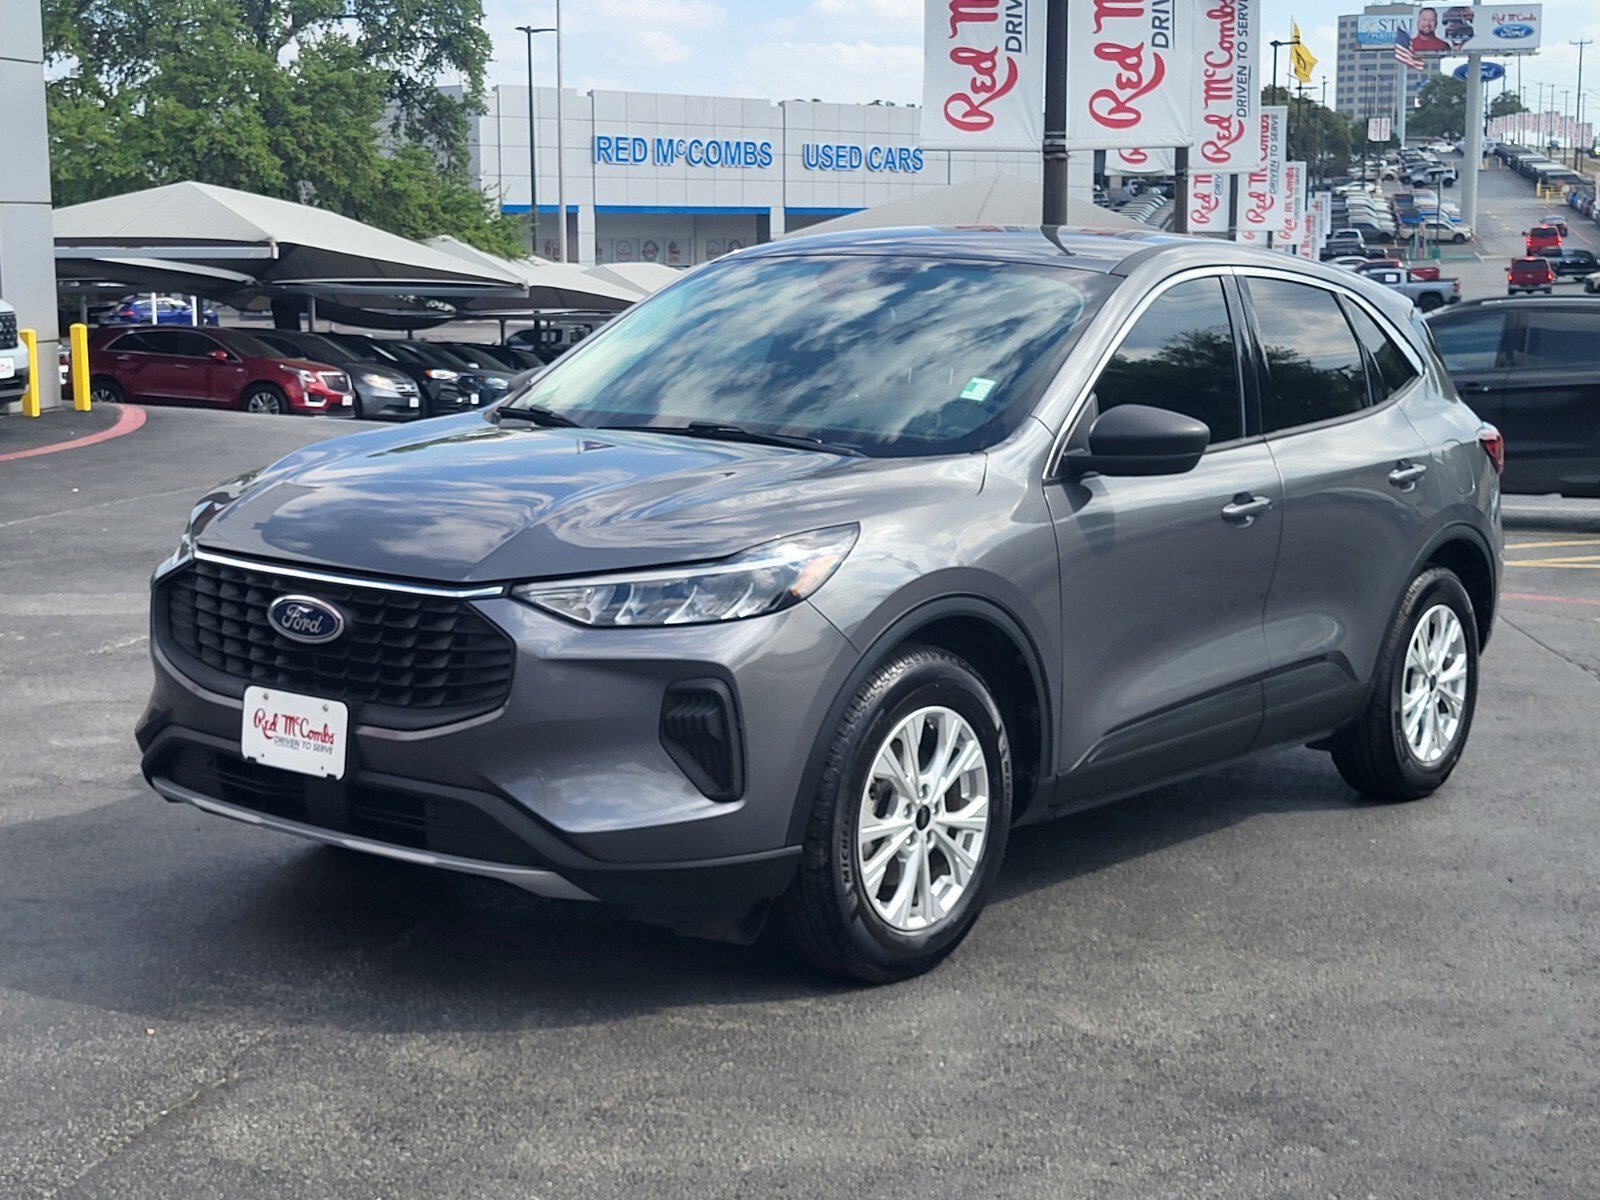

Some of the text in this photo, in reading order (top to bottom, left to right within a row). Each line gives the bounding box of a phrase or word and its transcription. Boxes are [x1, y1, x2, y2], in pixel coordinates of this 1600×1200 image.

[1005, 0, 1023, 53] DRIV
[1236, 0, 1248, 118] DRIVEN TO SERV
[944, 45, 1018, 132] Red
[1089, 41, 1165, 129] Red
[596, 135, 648, 163] RED
[804, 144, 863, 169] USED
[869, 146, 924, 171] CARS
[1201, 114, 1244, 164] Red
[281, 603, 324, 634] Ford
[253, 707, 336, 745] Red McCombs
[274, 736, 334, 755] DRIVEN TO SERVE
